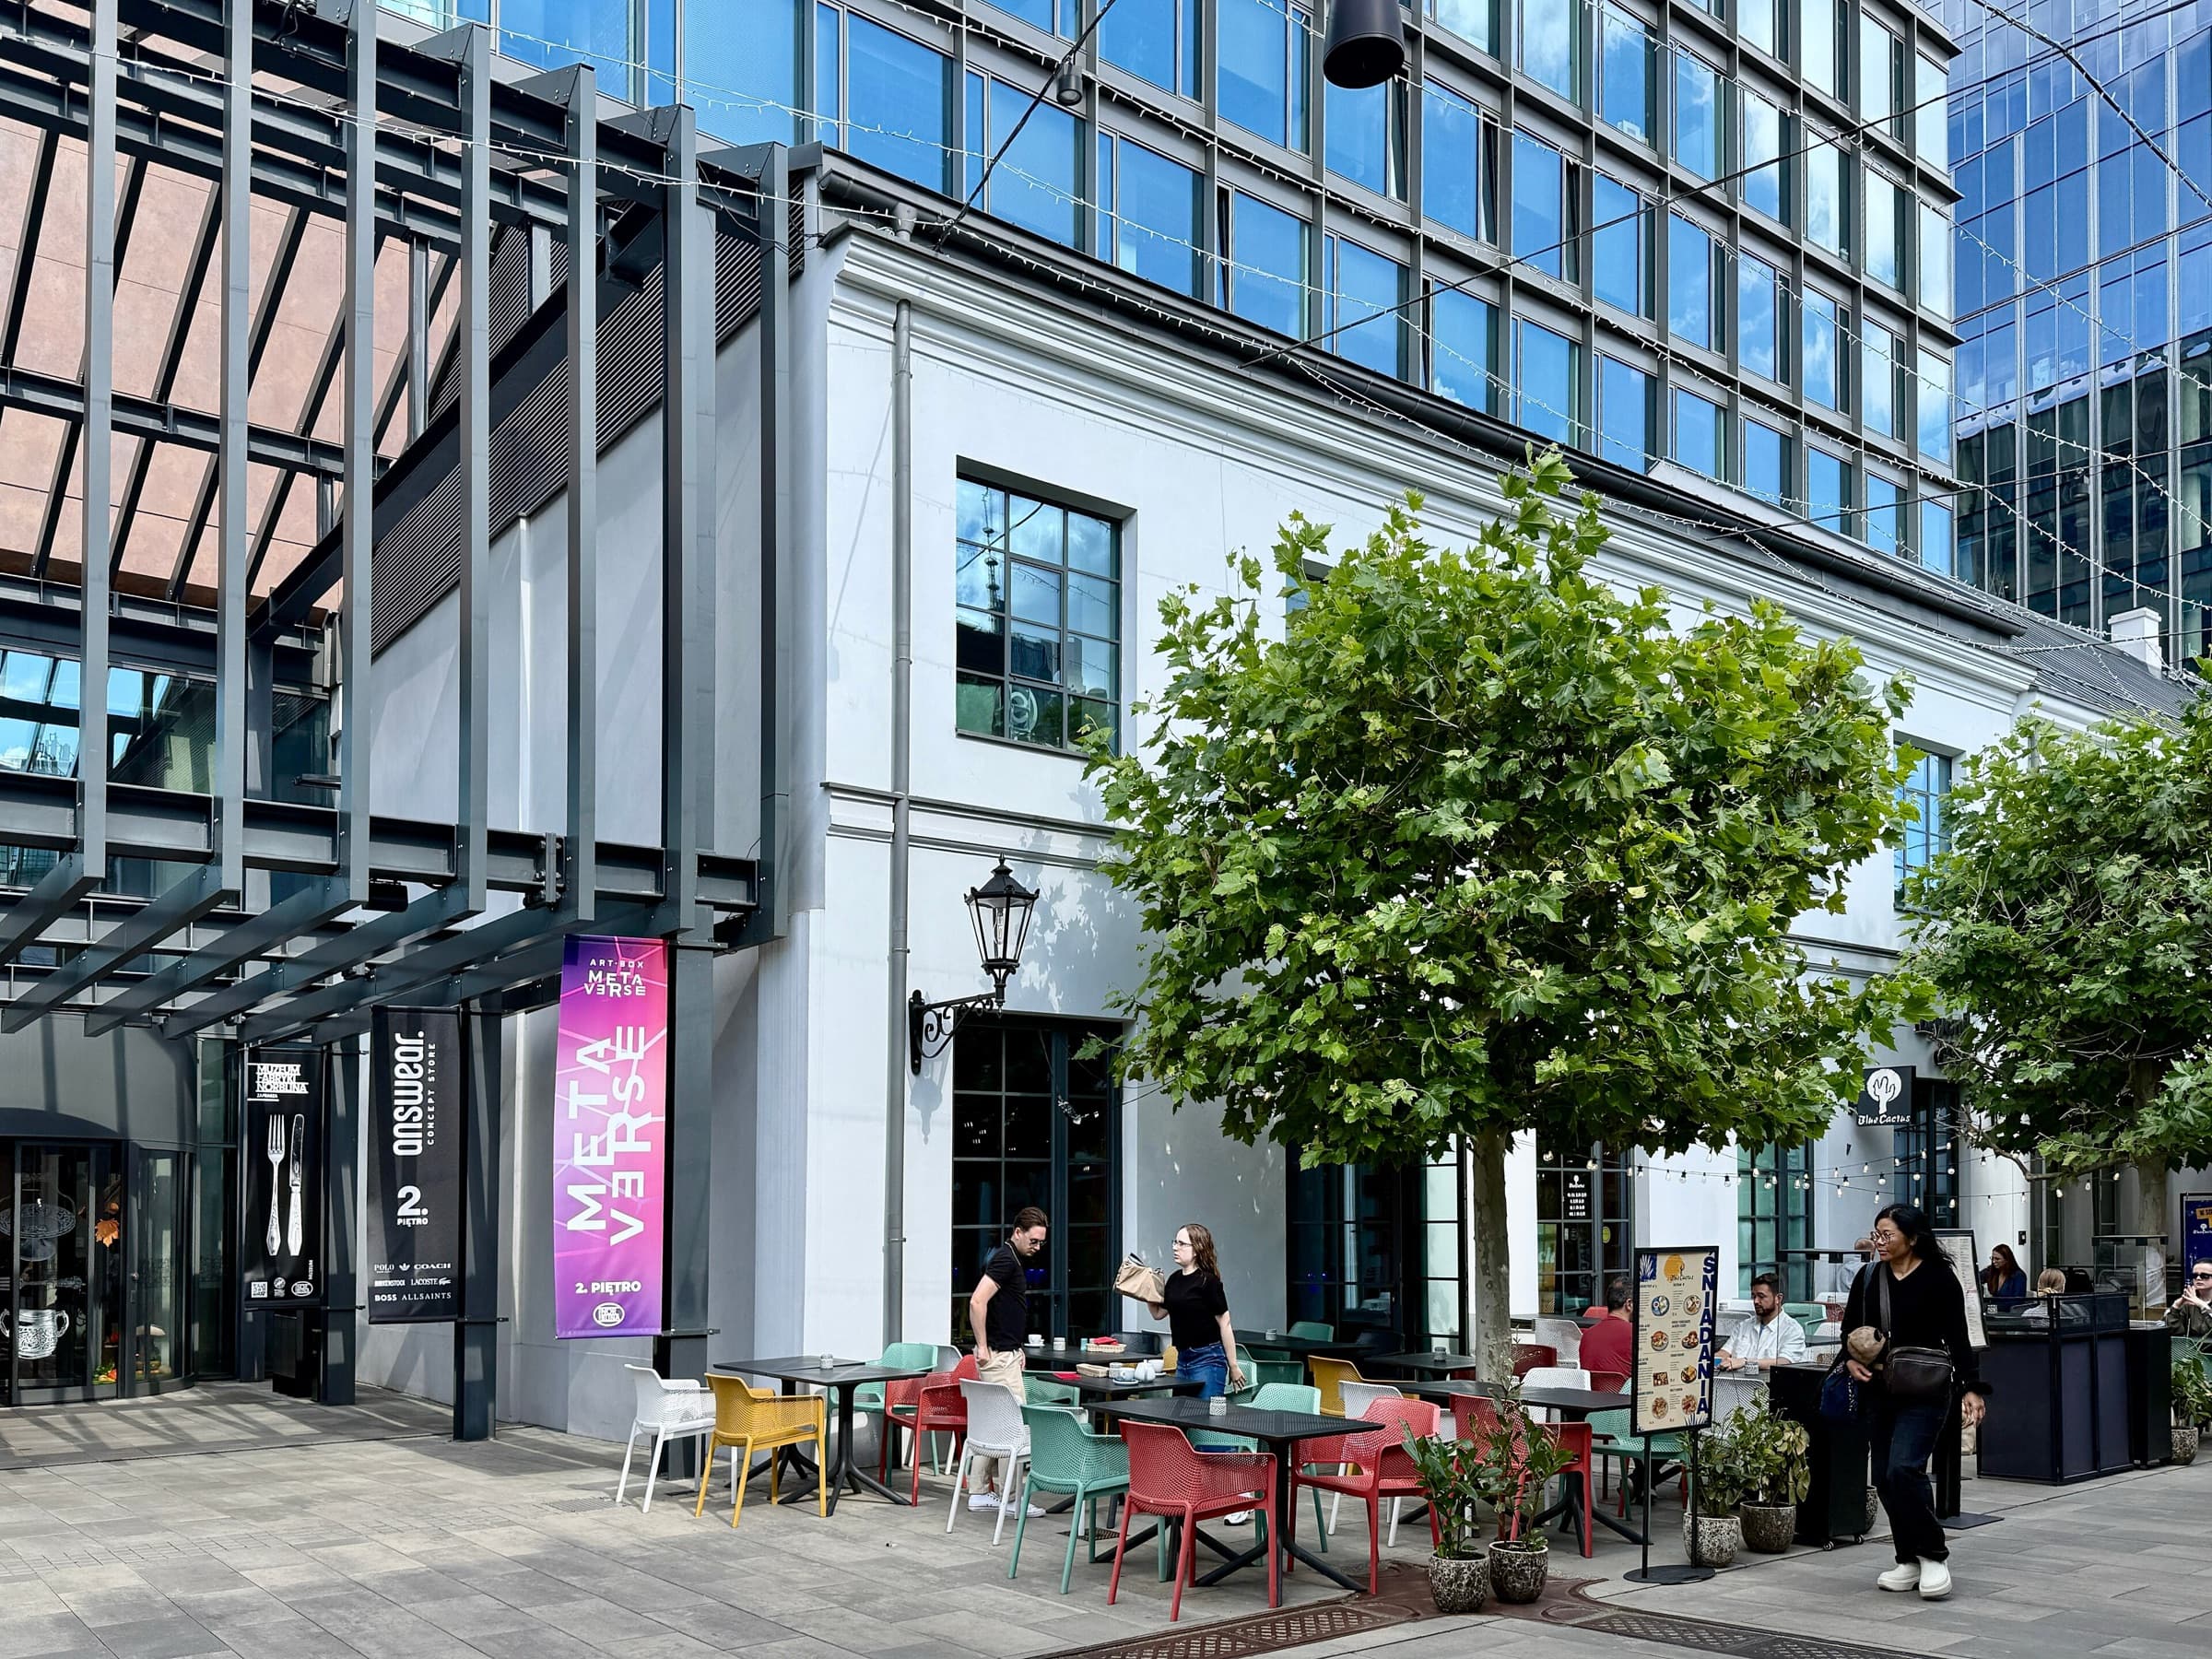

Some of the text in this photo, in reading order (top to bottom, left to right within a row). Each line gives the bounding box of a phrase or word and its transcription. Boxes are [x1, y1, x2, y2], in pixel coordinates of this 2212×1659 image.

[588, 970, 642, 985] META
[257, 1064, 300, 1075] MUZEUM
[256, 1083, 308, 1092] NORBLINA
[393, 1030, 425, 1157] answear.
[427, 1043, 436, 1146] CONCEPT STORE
[1879, 1114, 1911, 1124] Cactus
[567, 1037, 615, 1230] META
[397, 1185, 429, 1216] 2.
[397, 1218, 429, 1227] PIĘTRO
[410, 1277, 438, 1286] LACOSTE
[575, 1280, 641, 1296] 2. PIĘTRO
[374, 1292, 452, 1301] BOSS ALLSAINTS
